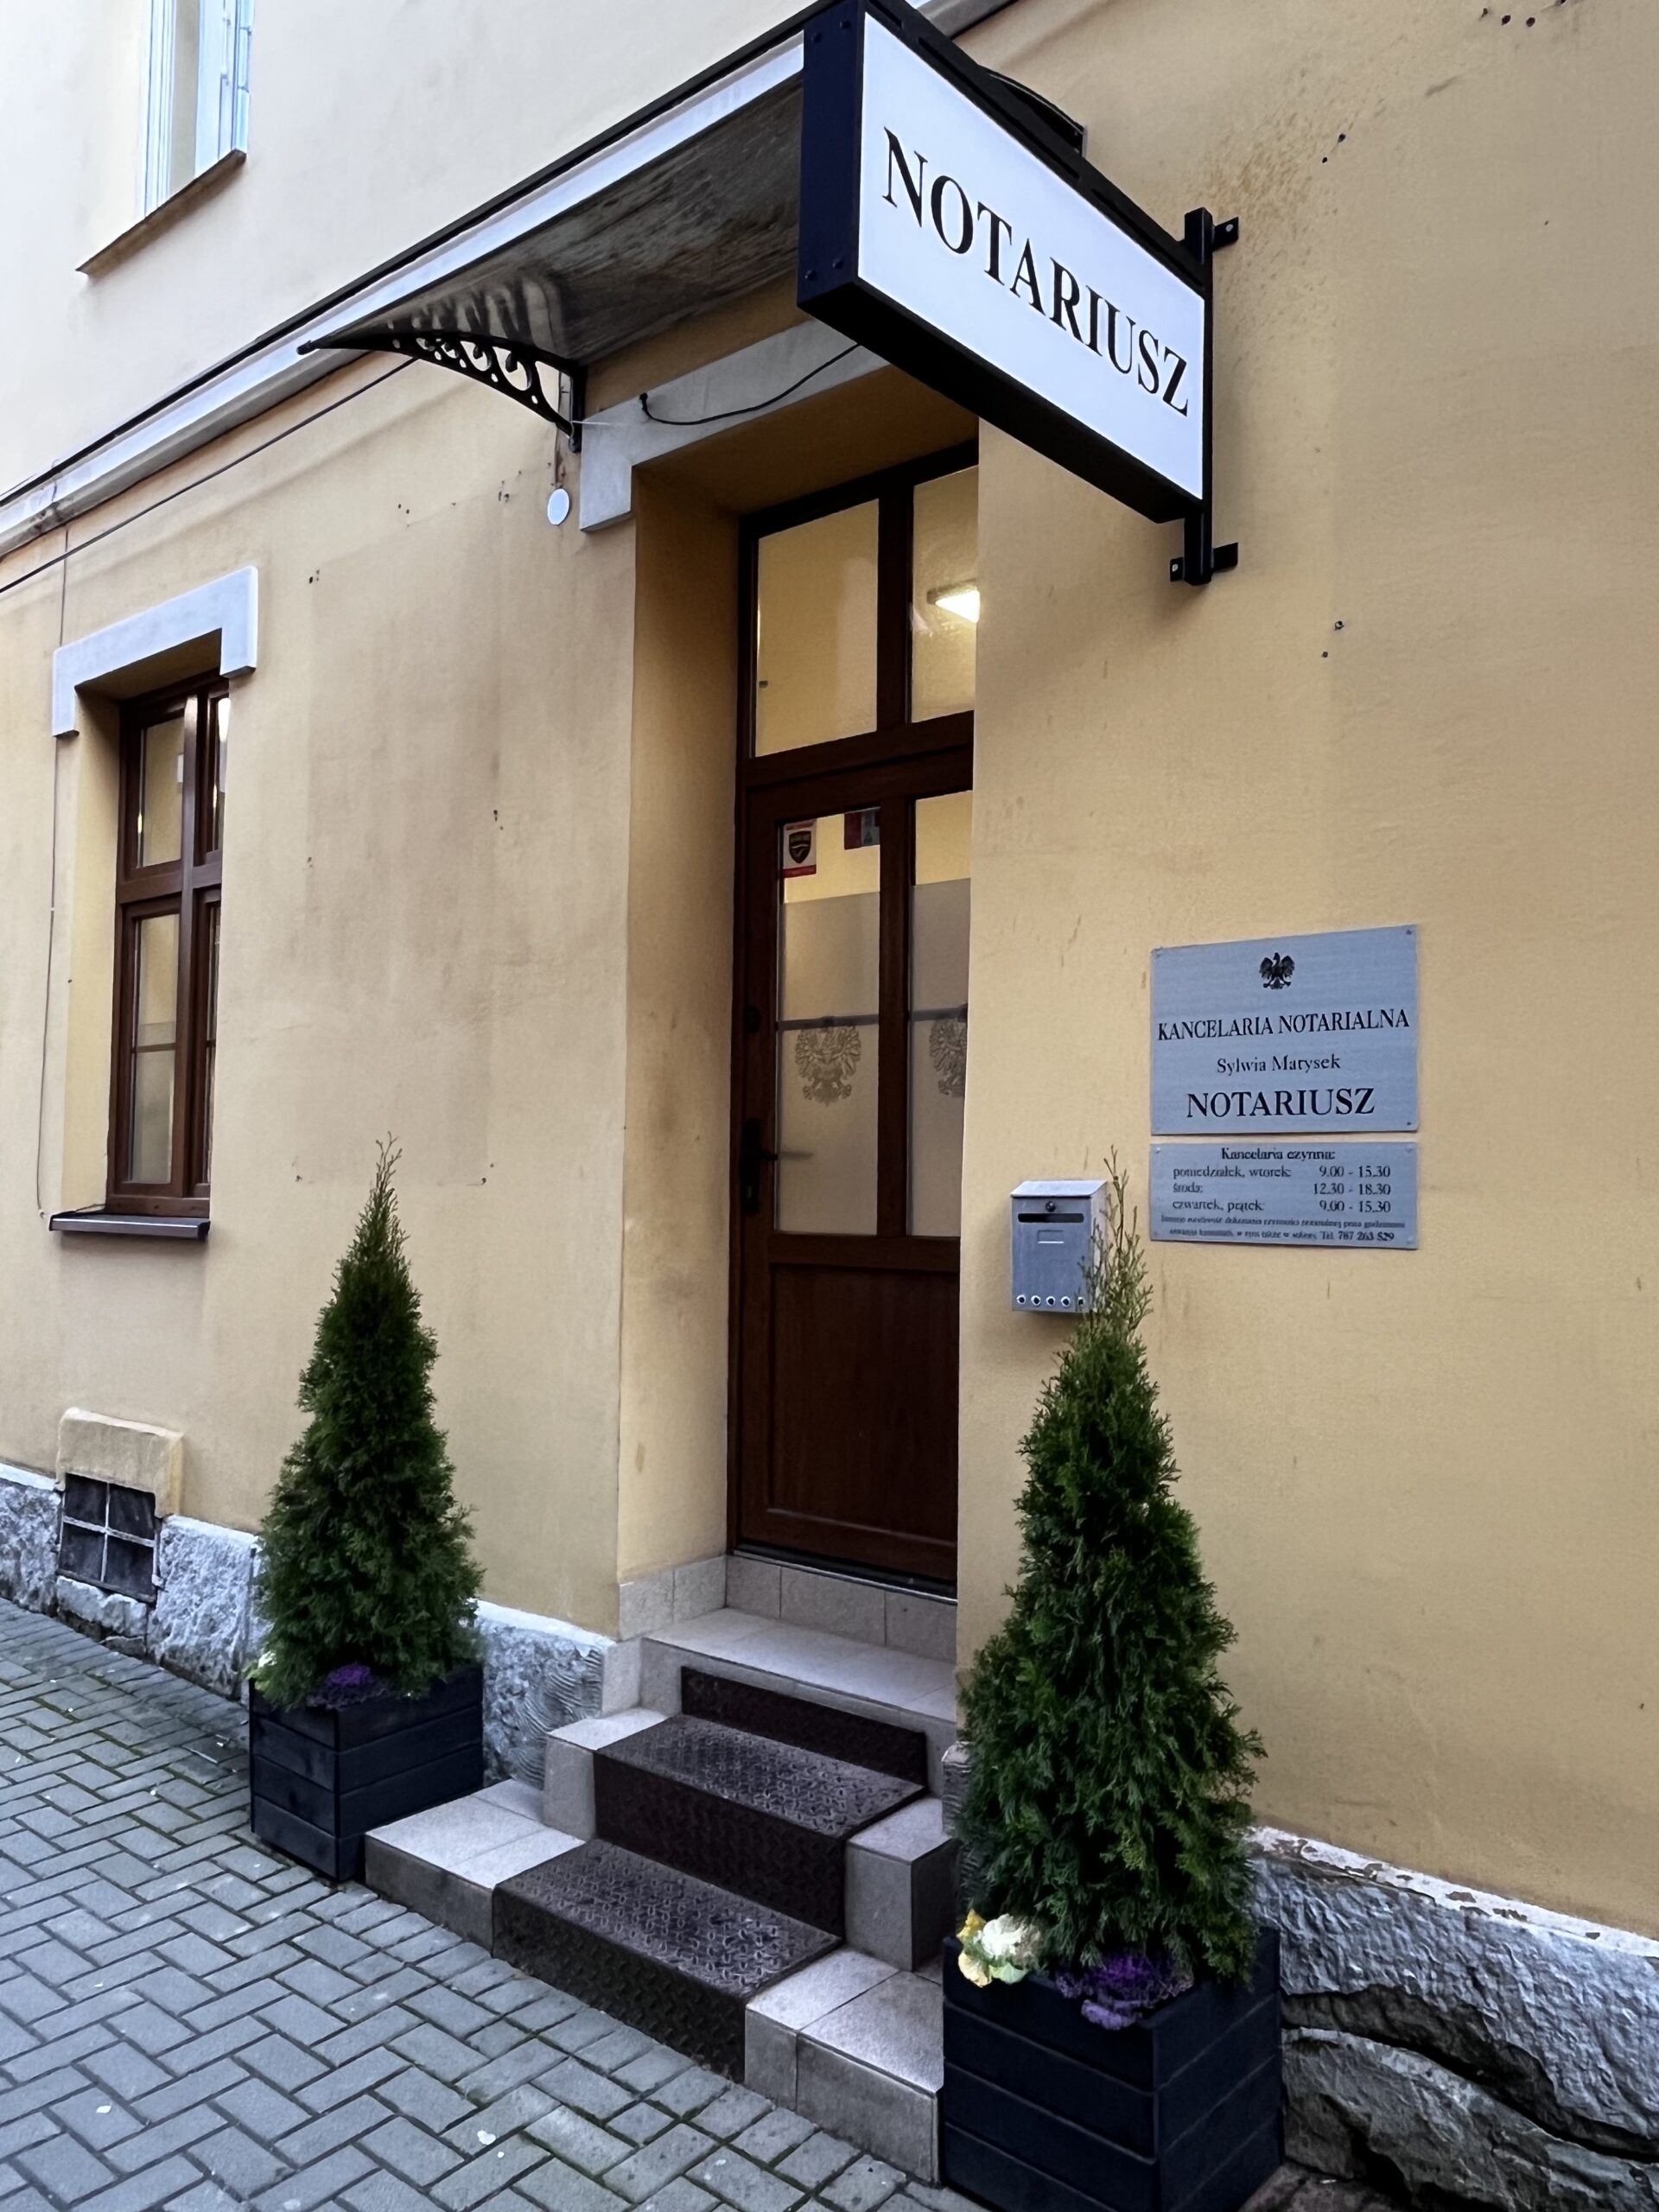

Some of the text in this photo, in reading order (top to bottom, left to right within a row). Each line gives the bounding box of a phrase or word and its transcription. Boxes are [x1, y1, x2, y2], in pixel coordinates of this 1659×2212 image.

[882, 126, 1188, 416] NOTARIUSZ
[1158, 1008, 1410, 1040] KANCELARIA NOTARIALNA
[1217, 1057, 1267, 1076] Sylwia
[1187, 1087, 1376, 1118] NOTARIUSZ
[1222, 1147, 1283, 1160] Kancelaria
[1319, 1165, 1344, 1178] 9.00
[1358, 1165, 1391, 1178] 15.30
[1313, 1182, 1344, 1195] 12.30
[1358, 1183, 1391, 1195] 18.30
[1319, 1199, 1345, 1212] 9.00
[1358, 1200, 1391, 1213] 15.30
